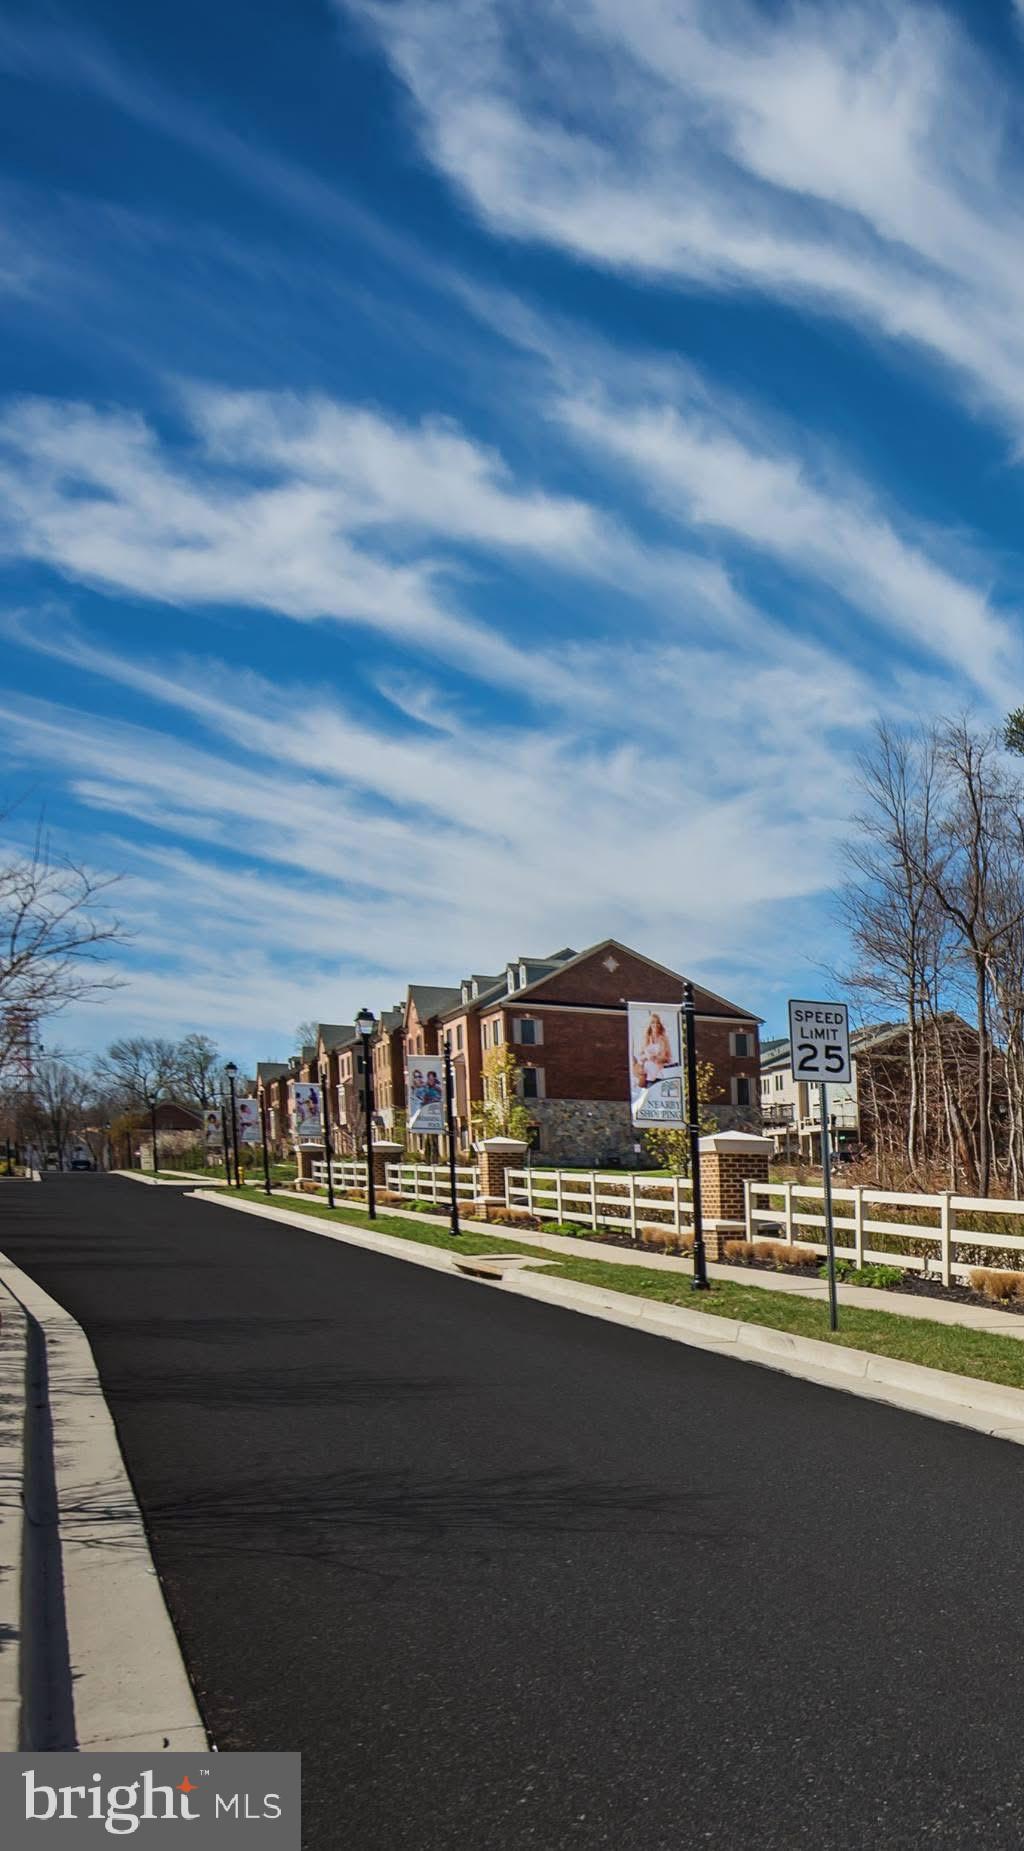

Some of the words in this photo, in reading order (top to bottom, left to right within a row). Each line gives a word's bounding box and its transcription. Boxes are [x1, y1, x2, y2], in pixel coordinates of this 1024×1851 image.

[794, 1010, 844, 1024] SPEED
[800, 1028, 839, 1041] LIMIT
[797, 1044, 845, 1074] 25
